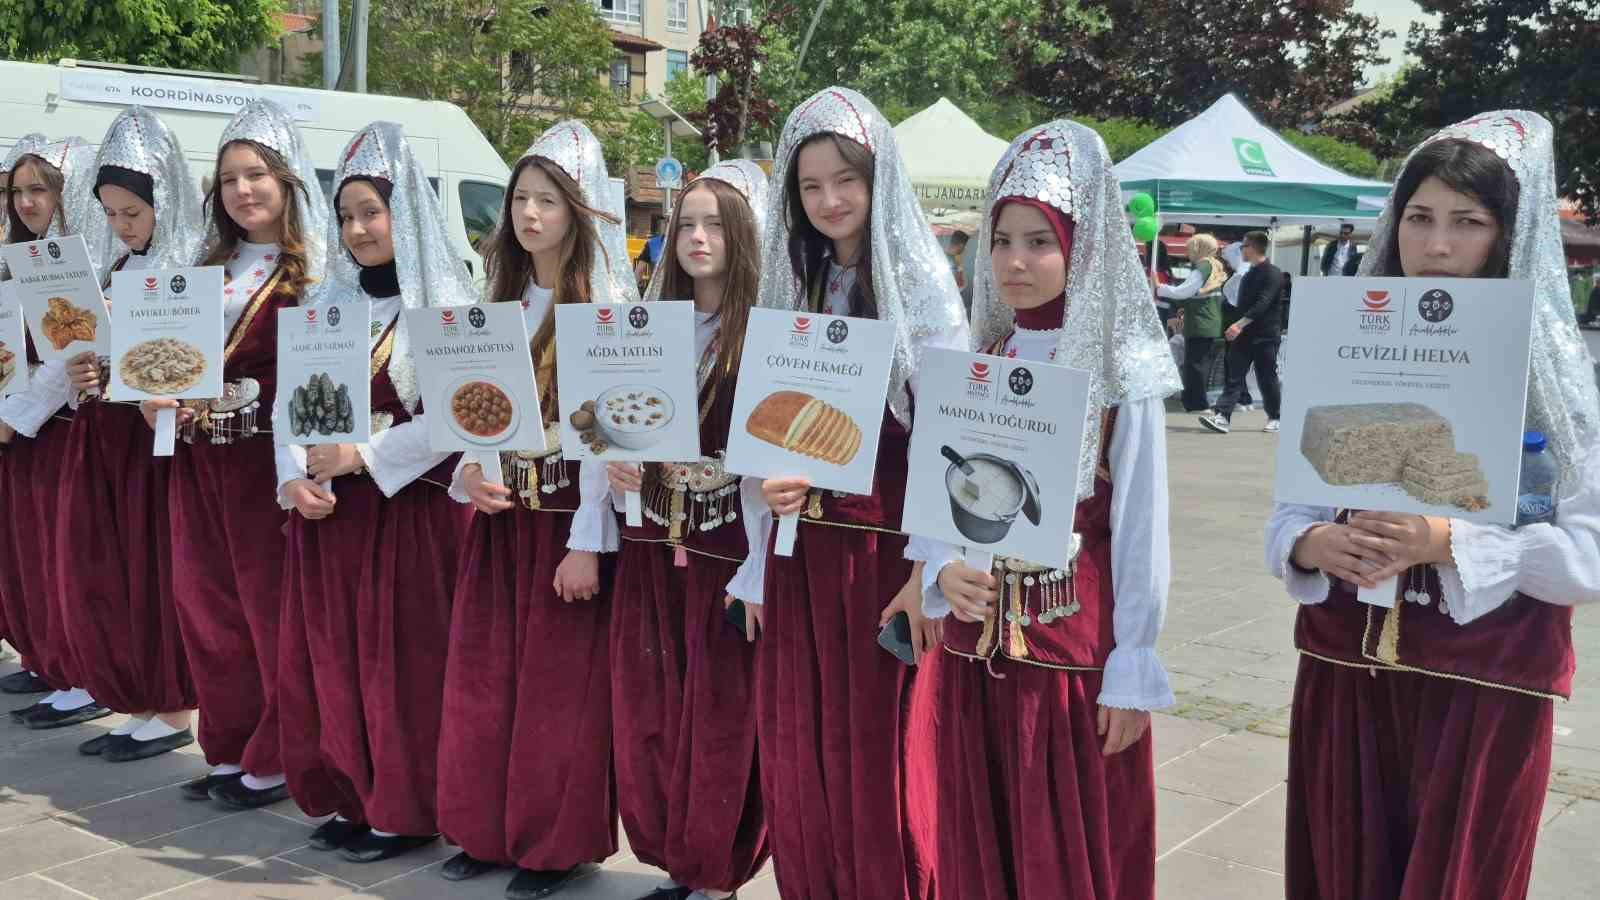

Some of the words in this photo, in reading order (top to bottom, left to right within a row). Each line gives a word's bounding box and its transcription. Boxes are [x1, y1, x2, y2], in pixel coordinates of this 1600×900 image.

[131, 86, 256, 106] KOORDİNASYON
[1360, 313, 1390, 324] TÜRK
[586, 344, 618, 357] AĞDA
[622, 346, 663, 357] TATLISI
[1337, 344, 1408, 361] CEVİZLİ
[1413, 348, 1471, 364] HELVA
[766, 354, 811, 369] ÇÖVEN
[968, 383, 989, 393] TÜRK
[938, 405, 985, 423] MANDA
[989, 413, 1057, 435] YOĞURDU
